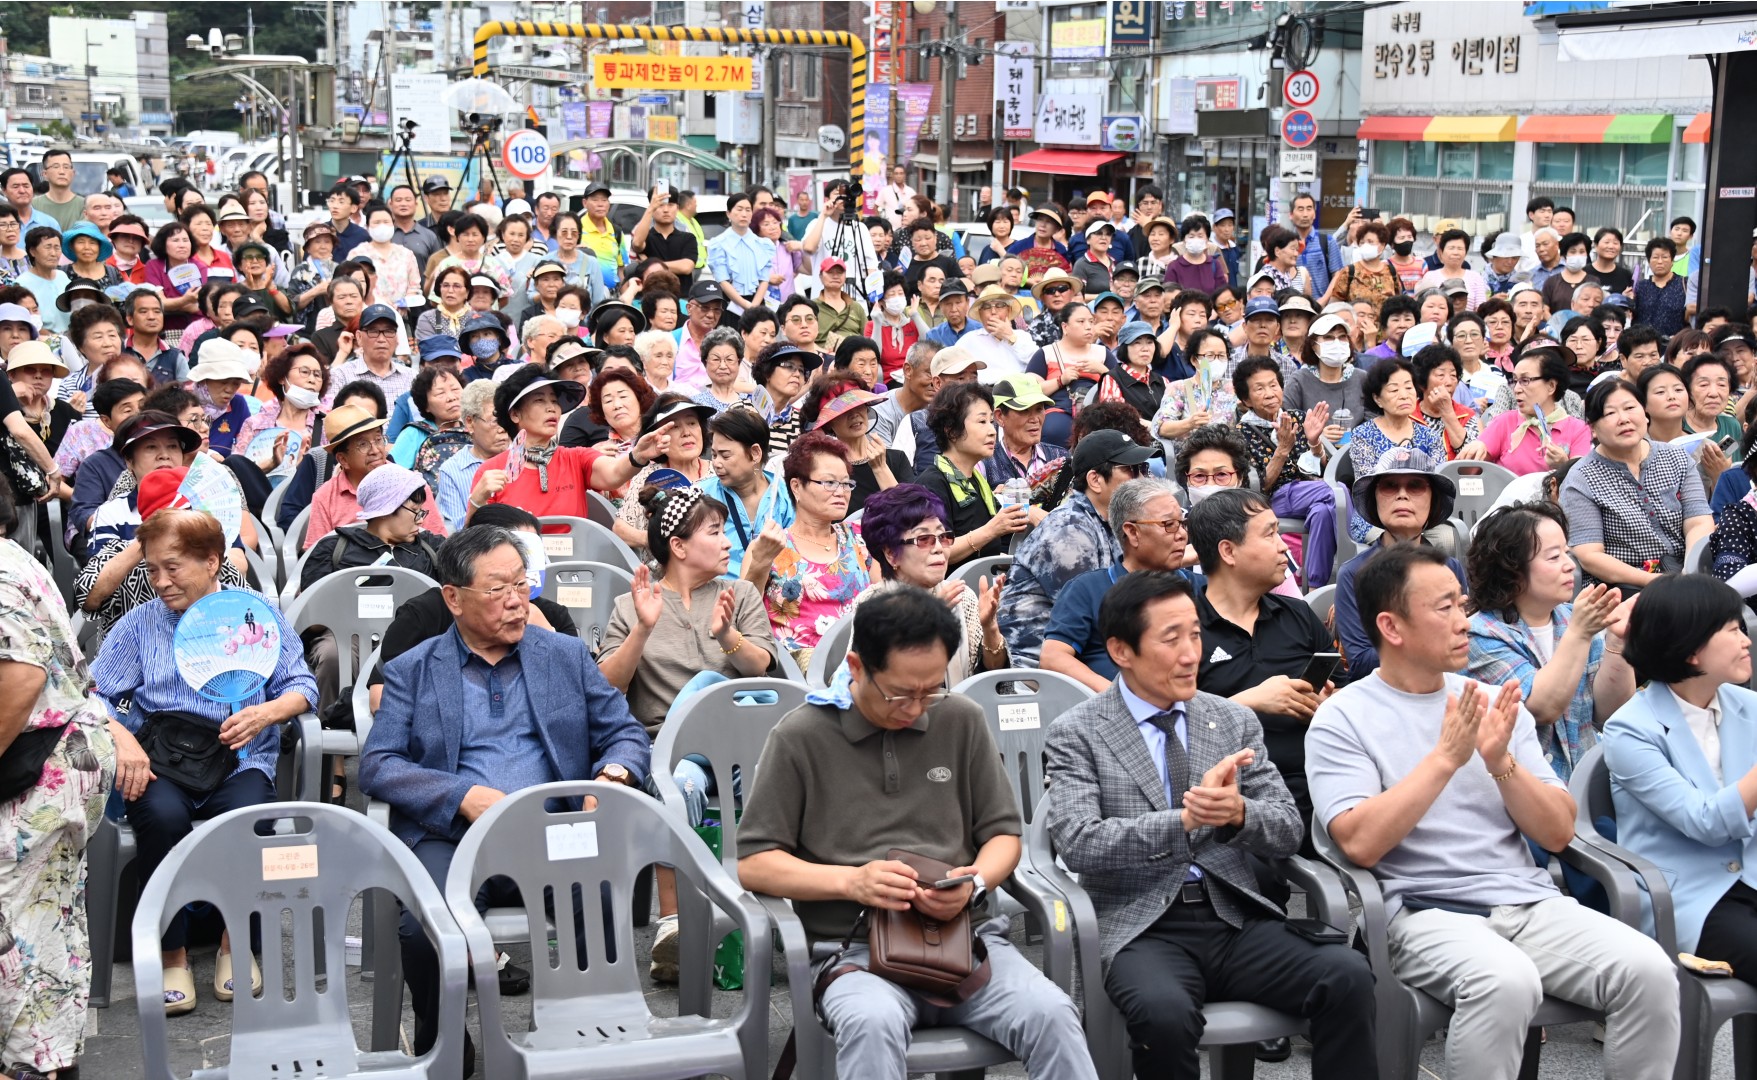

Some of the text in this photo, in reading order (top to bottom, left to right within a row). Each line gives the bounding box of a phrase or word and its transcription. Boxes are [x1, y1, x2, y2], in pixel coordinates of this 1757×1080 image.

[1375, 34, 1520, 78] 반송2동 어린이집
[603, 62, 699, 82] 통과제한높이
[705, 65, 744, 82] 2.7M
[1216, 84, 1236, 107] 컴퓨터
[1292, 80, 1311, 97] 30
[511, 146, 546, 163] 108
